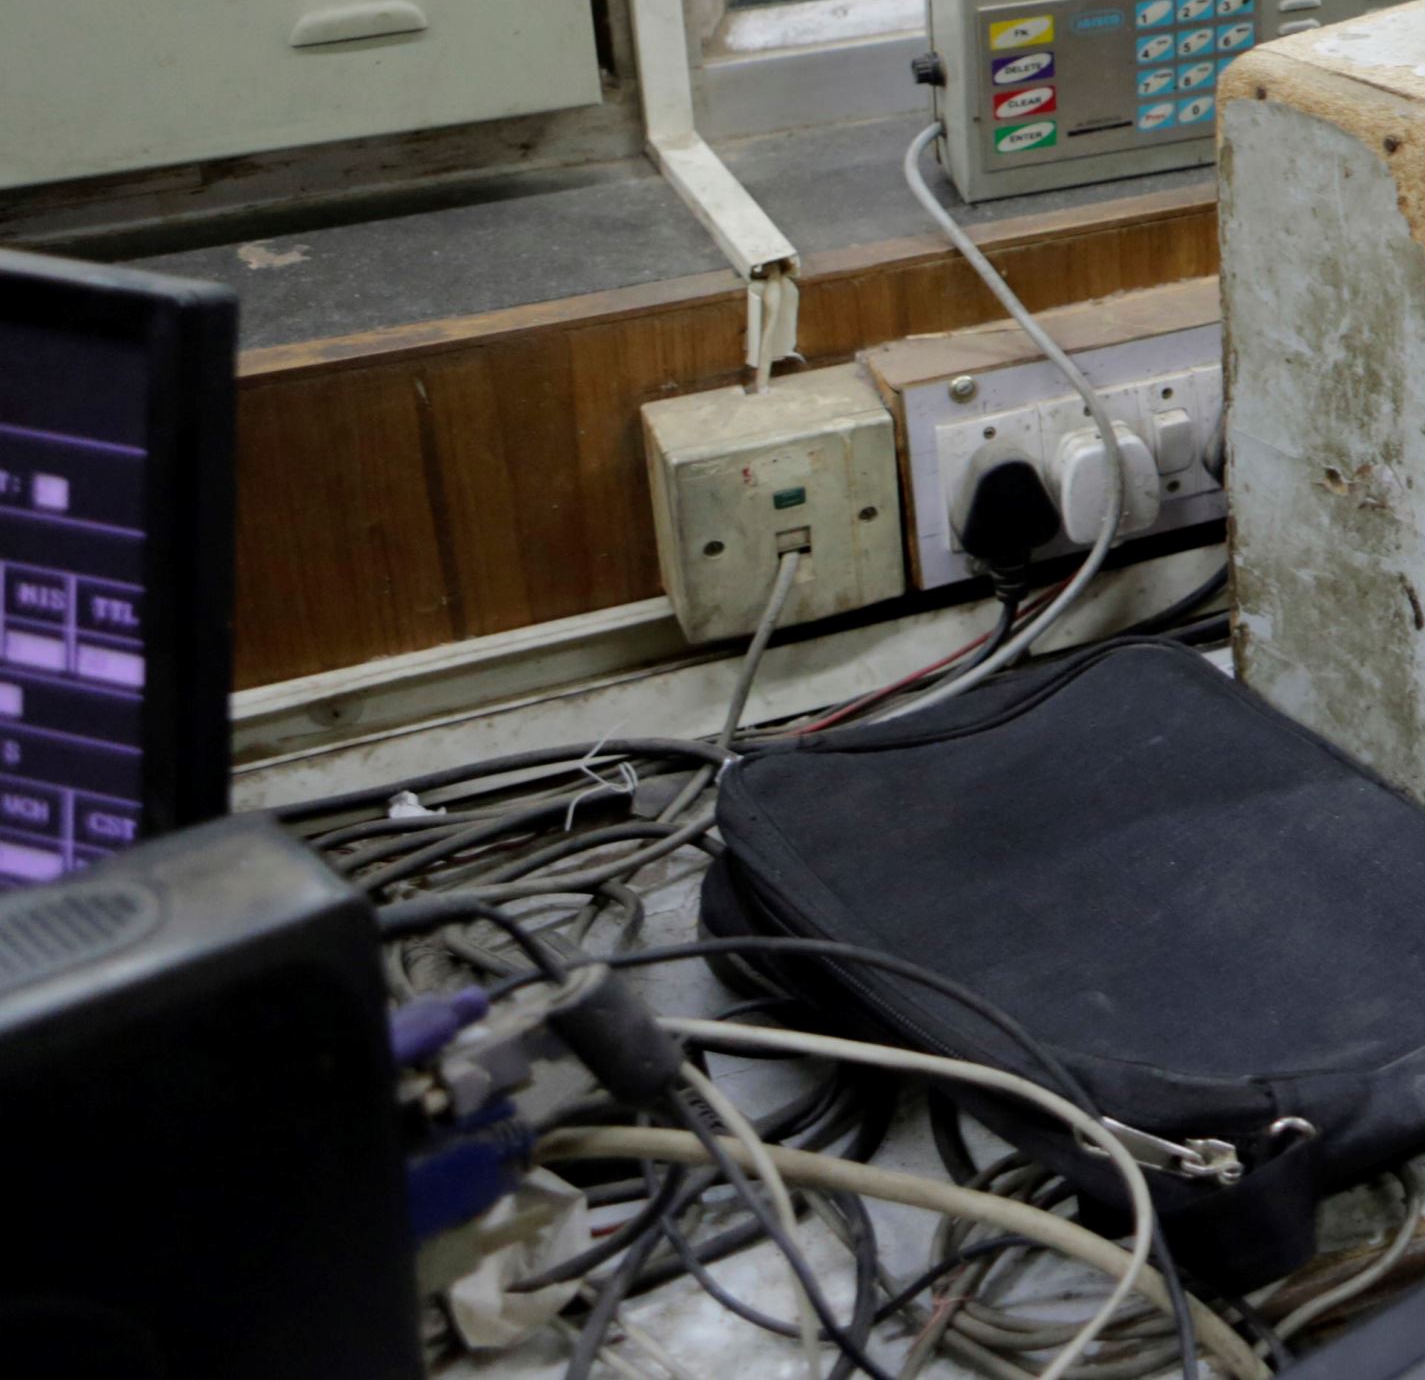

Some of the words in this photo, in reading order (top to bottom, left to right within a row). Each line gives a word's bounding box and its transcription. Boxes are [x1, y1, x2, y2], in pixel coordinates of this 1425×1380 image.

[1005, 62, 1042, 75] DELETE
[1008, 96, 1042, 109] CLEAR
[1009, 131, 1043, 143] ENTER
